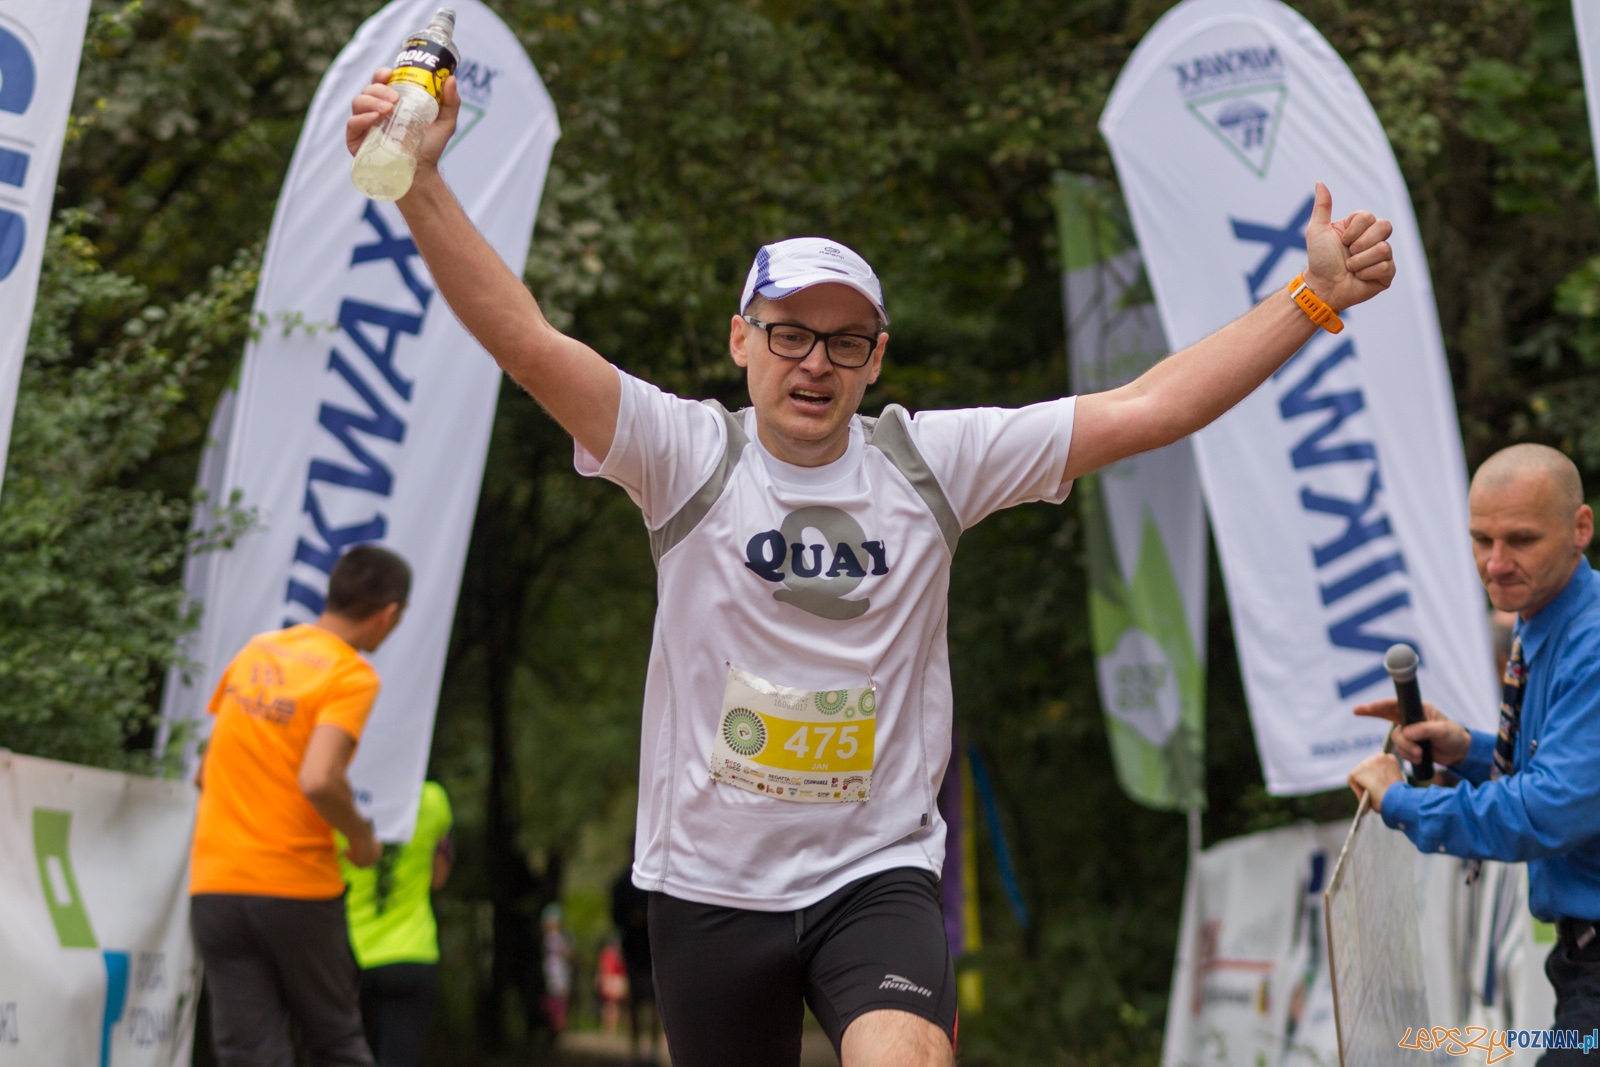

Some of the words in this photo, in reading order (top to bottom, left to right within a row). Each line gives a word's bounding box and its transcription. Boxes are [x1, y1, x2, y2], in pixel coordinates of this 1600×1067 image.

[744, 529, 890, 582] QUAY
[783, 725, 859, 760] 475
[811, 763, 829, 771] JAN
[768, 774, 791, 782] REGATTA
